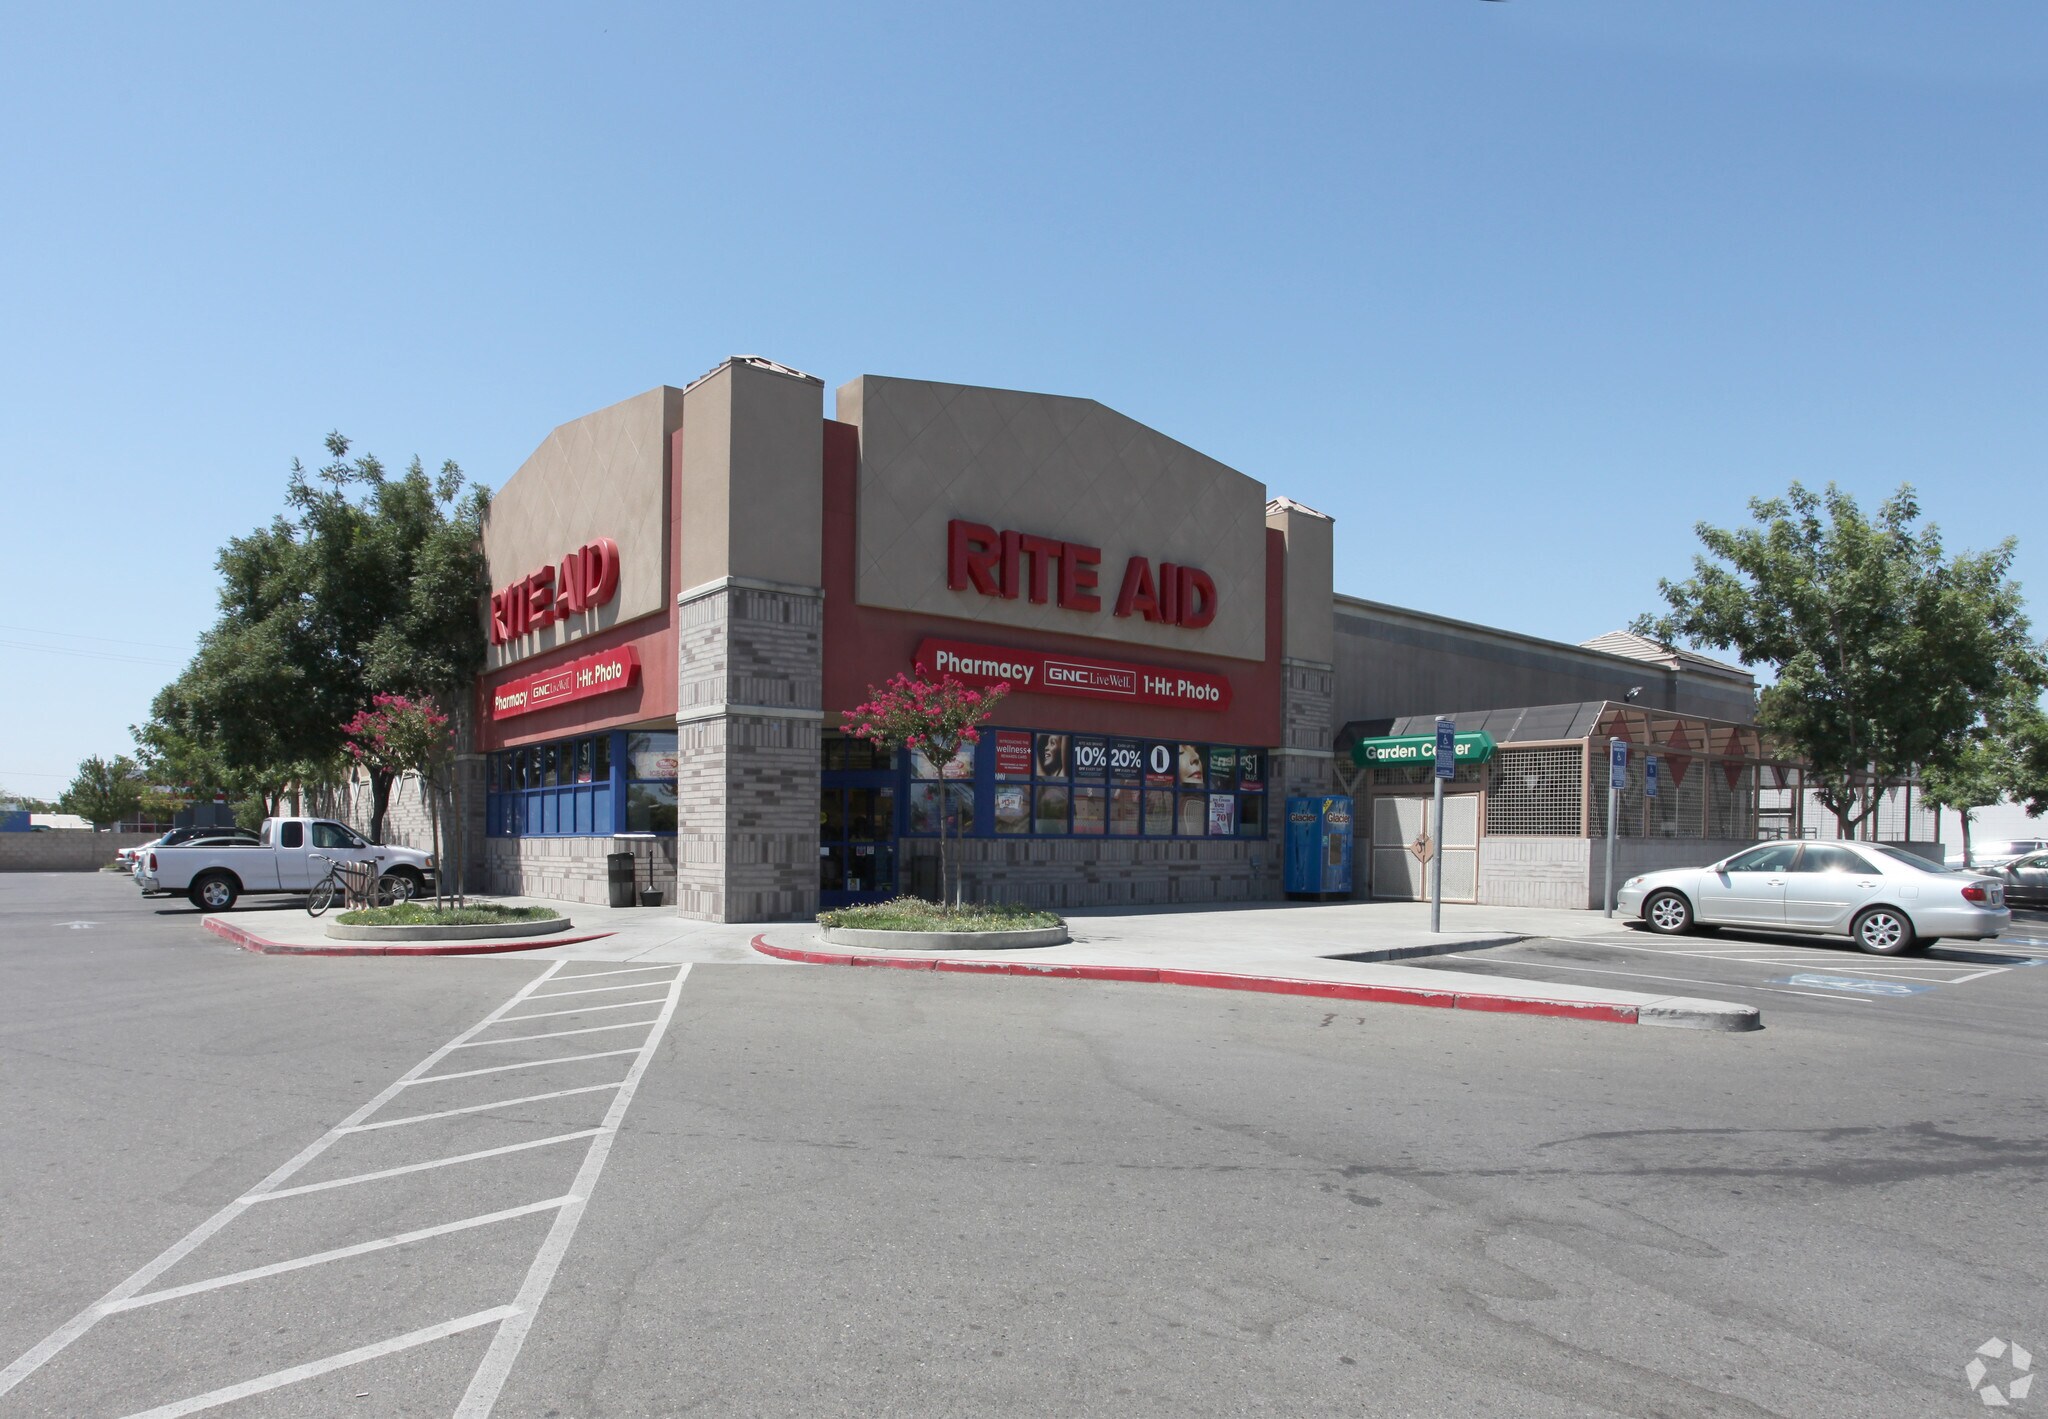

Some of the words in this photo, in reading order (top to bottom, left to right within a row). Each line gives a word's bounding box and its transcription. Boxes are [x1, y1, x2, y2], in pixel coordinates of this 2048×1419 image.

[948, 519, 1101, 613] RITE
[1114, 555, 1217, 629] AID
[490, 565, 555, 645] RITE
[554, 536, 620, 620] AID
[495, 690, 528, 711] Pharmacy
[533, 683, 550, 698] GNC
[595, 661, 622, 684] Photo
[936, 650, 1034, 685] Pharmacy
[1049, 667, 1089, 684] GNC
[1143, 675, 1174, 696] 1-Hr.
[1177, 678, 1219, 702] Photo
[1074, 746, 1107, 767] 10%
[1111, 749, 1141, 768] 20%
[1366, 745, 1416, 760] Garden
[1245, 754, 1257, 774] $1
[1216, 813, 1226, 822] 70
[1289, 812, 1316, 822] Glacier
[1327, 812, 1350, 823] Glacier
